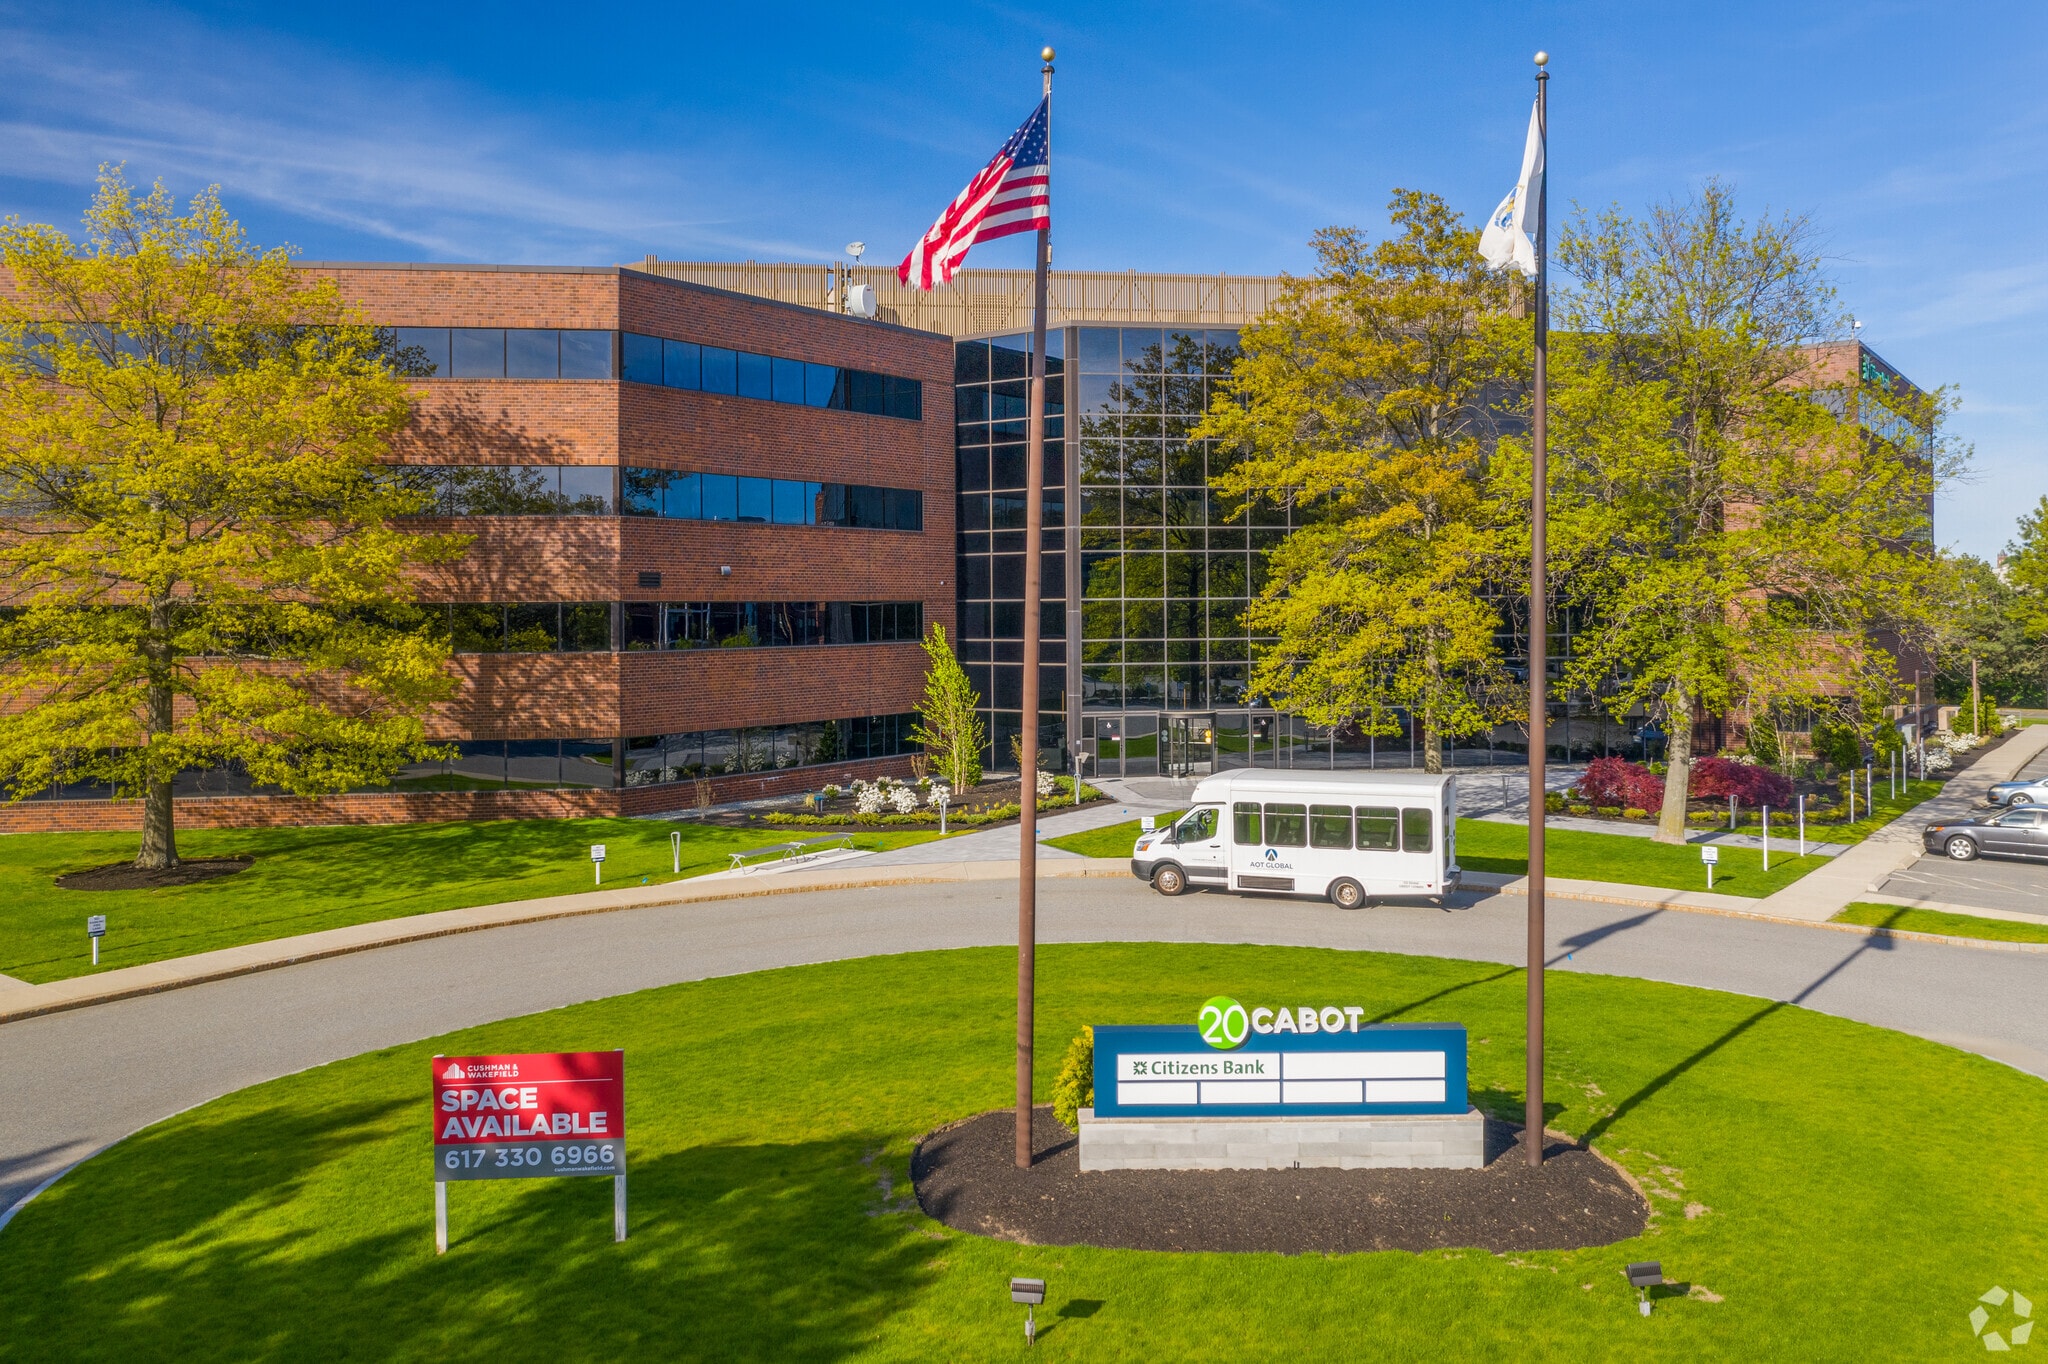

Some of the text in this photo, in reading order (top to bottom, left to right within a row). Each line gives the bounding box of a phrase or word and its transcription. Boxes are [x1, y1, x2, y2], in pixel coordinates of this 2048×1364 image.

[1199, 1004, 1364, 1043] 20 CABOT
[467, 1064, 511, 1072] CUSHMAN
[1151, 1059, 1265, 1076] Citizens Bank
[441, 1087, 538, 1112] SPACE
[442, 1111, 608, 1139] AVAILABLE
[445, 1144, 615, 1169] 617 330 6966
[554, 1165, 616, 1173] cushmanwakefield.com
